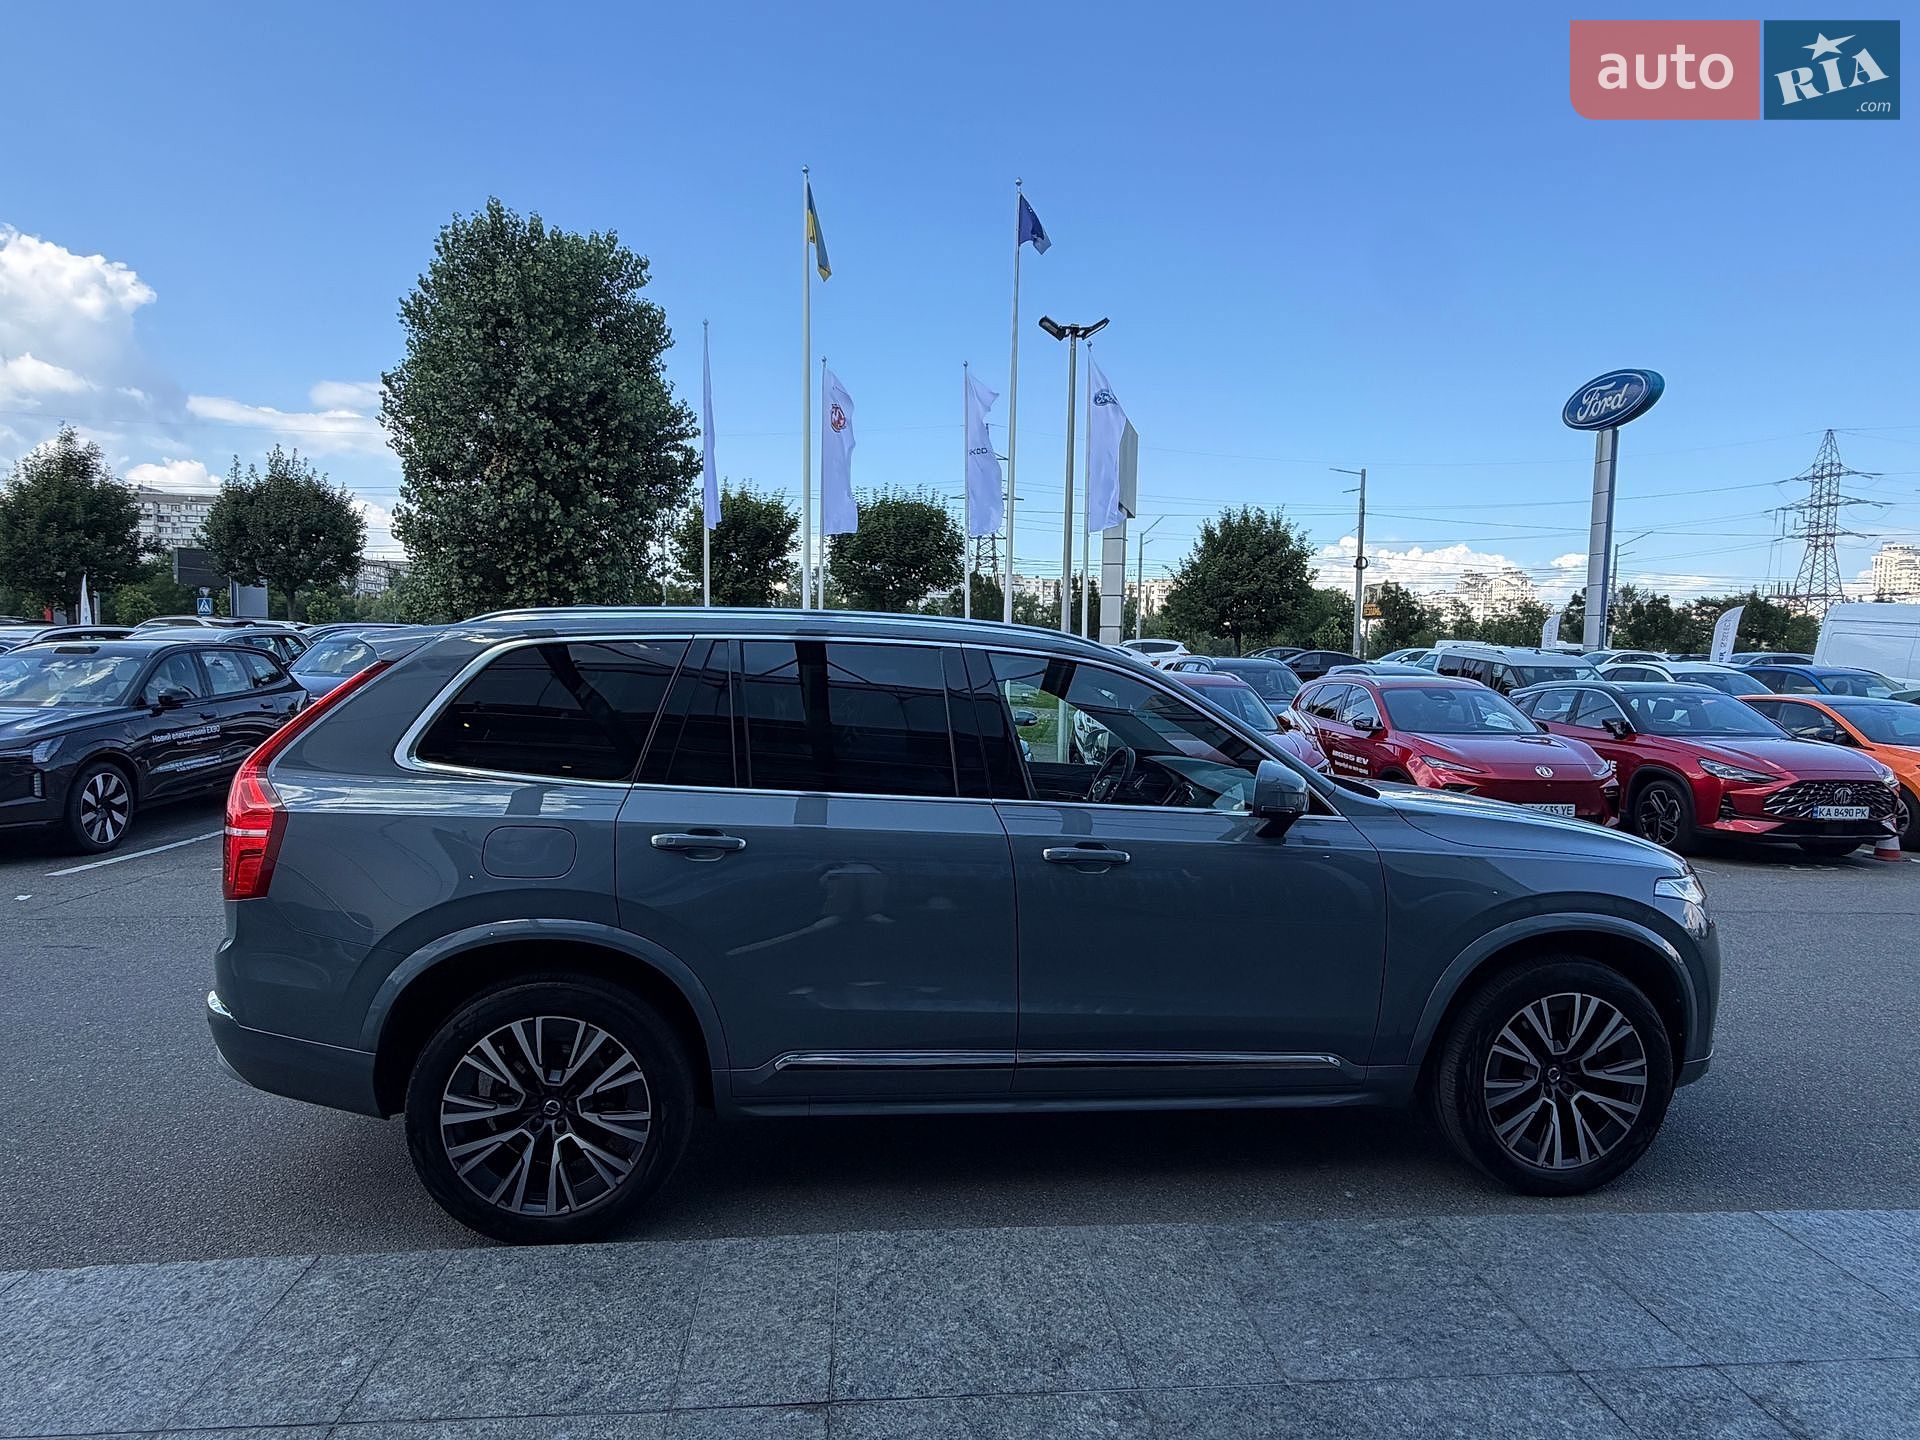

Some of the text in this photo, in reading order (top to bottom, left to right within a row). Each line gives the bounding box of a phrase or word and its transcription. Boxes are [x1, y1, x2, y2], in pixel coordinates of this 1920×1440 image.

[1577, 381, 1630, 421] Ford
[1356, 756, 1369, 765] EV
[1835, 788, 1852, 804] MG
[1560, 805, 1573, 816] YE
[1819, 808, 1867, 817] KA 8490 PK
